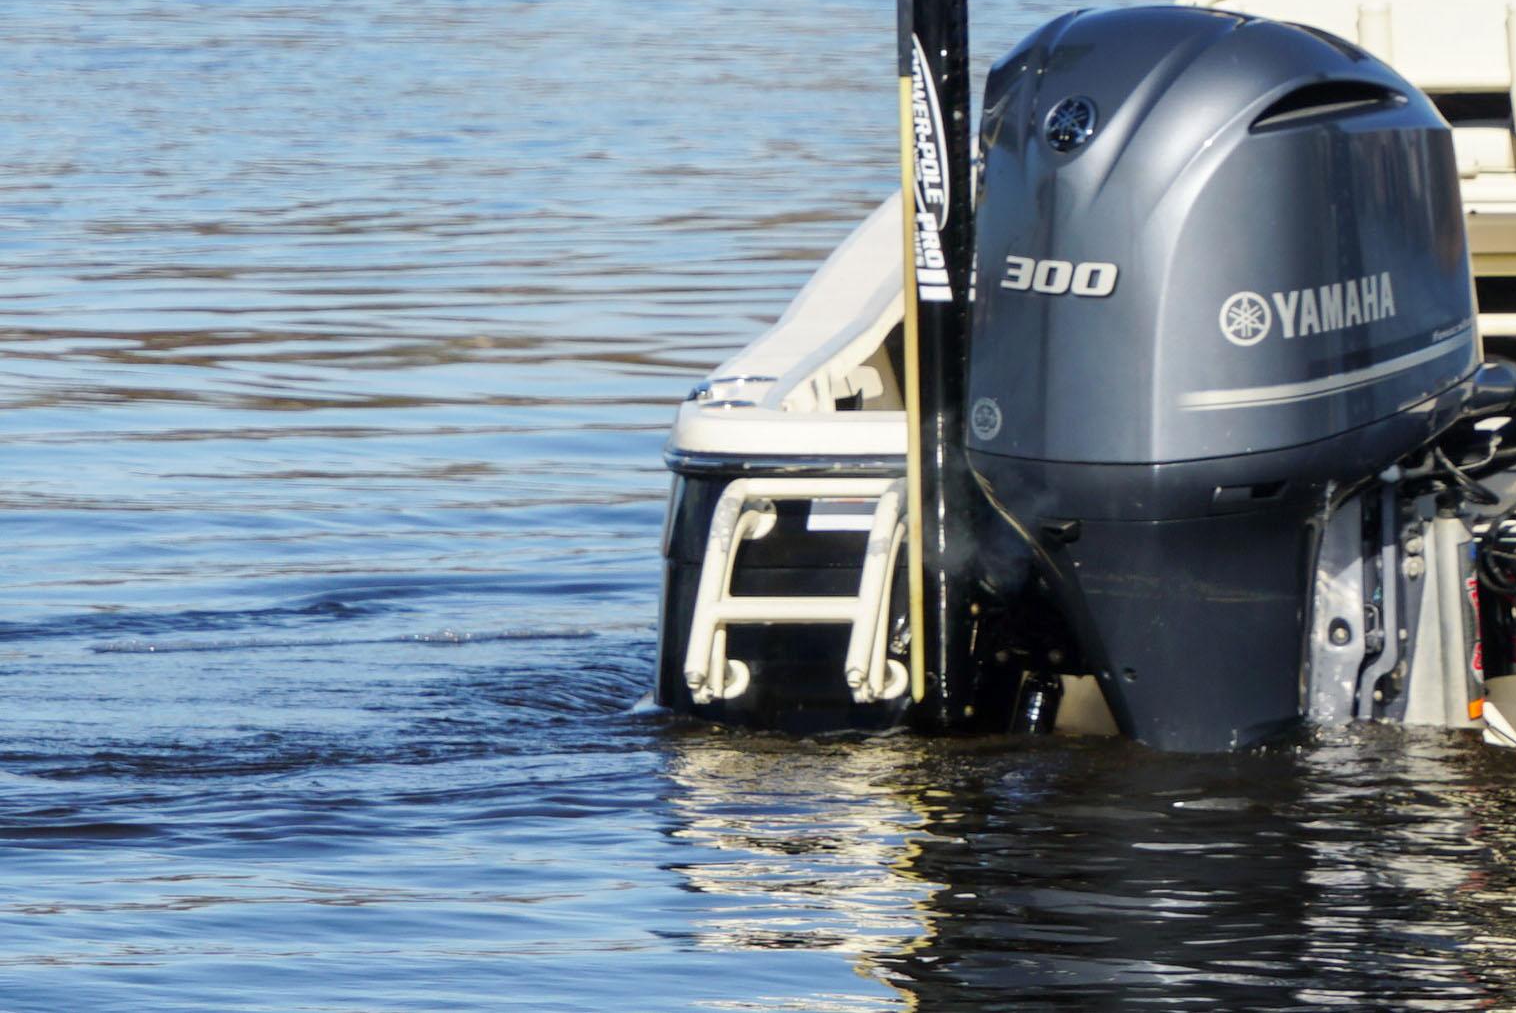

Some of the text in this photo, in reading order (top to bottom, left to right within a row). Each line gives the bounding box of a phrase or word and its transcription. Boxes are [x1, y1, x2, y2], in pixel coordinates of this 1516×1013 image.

[914, 212, 946, 268] PRO
[1000, 255, 1120, 298] 300
[1273, 272, 1397, 339] YAMAHA
